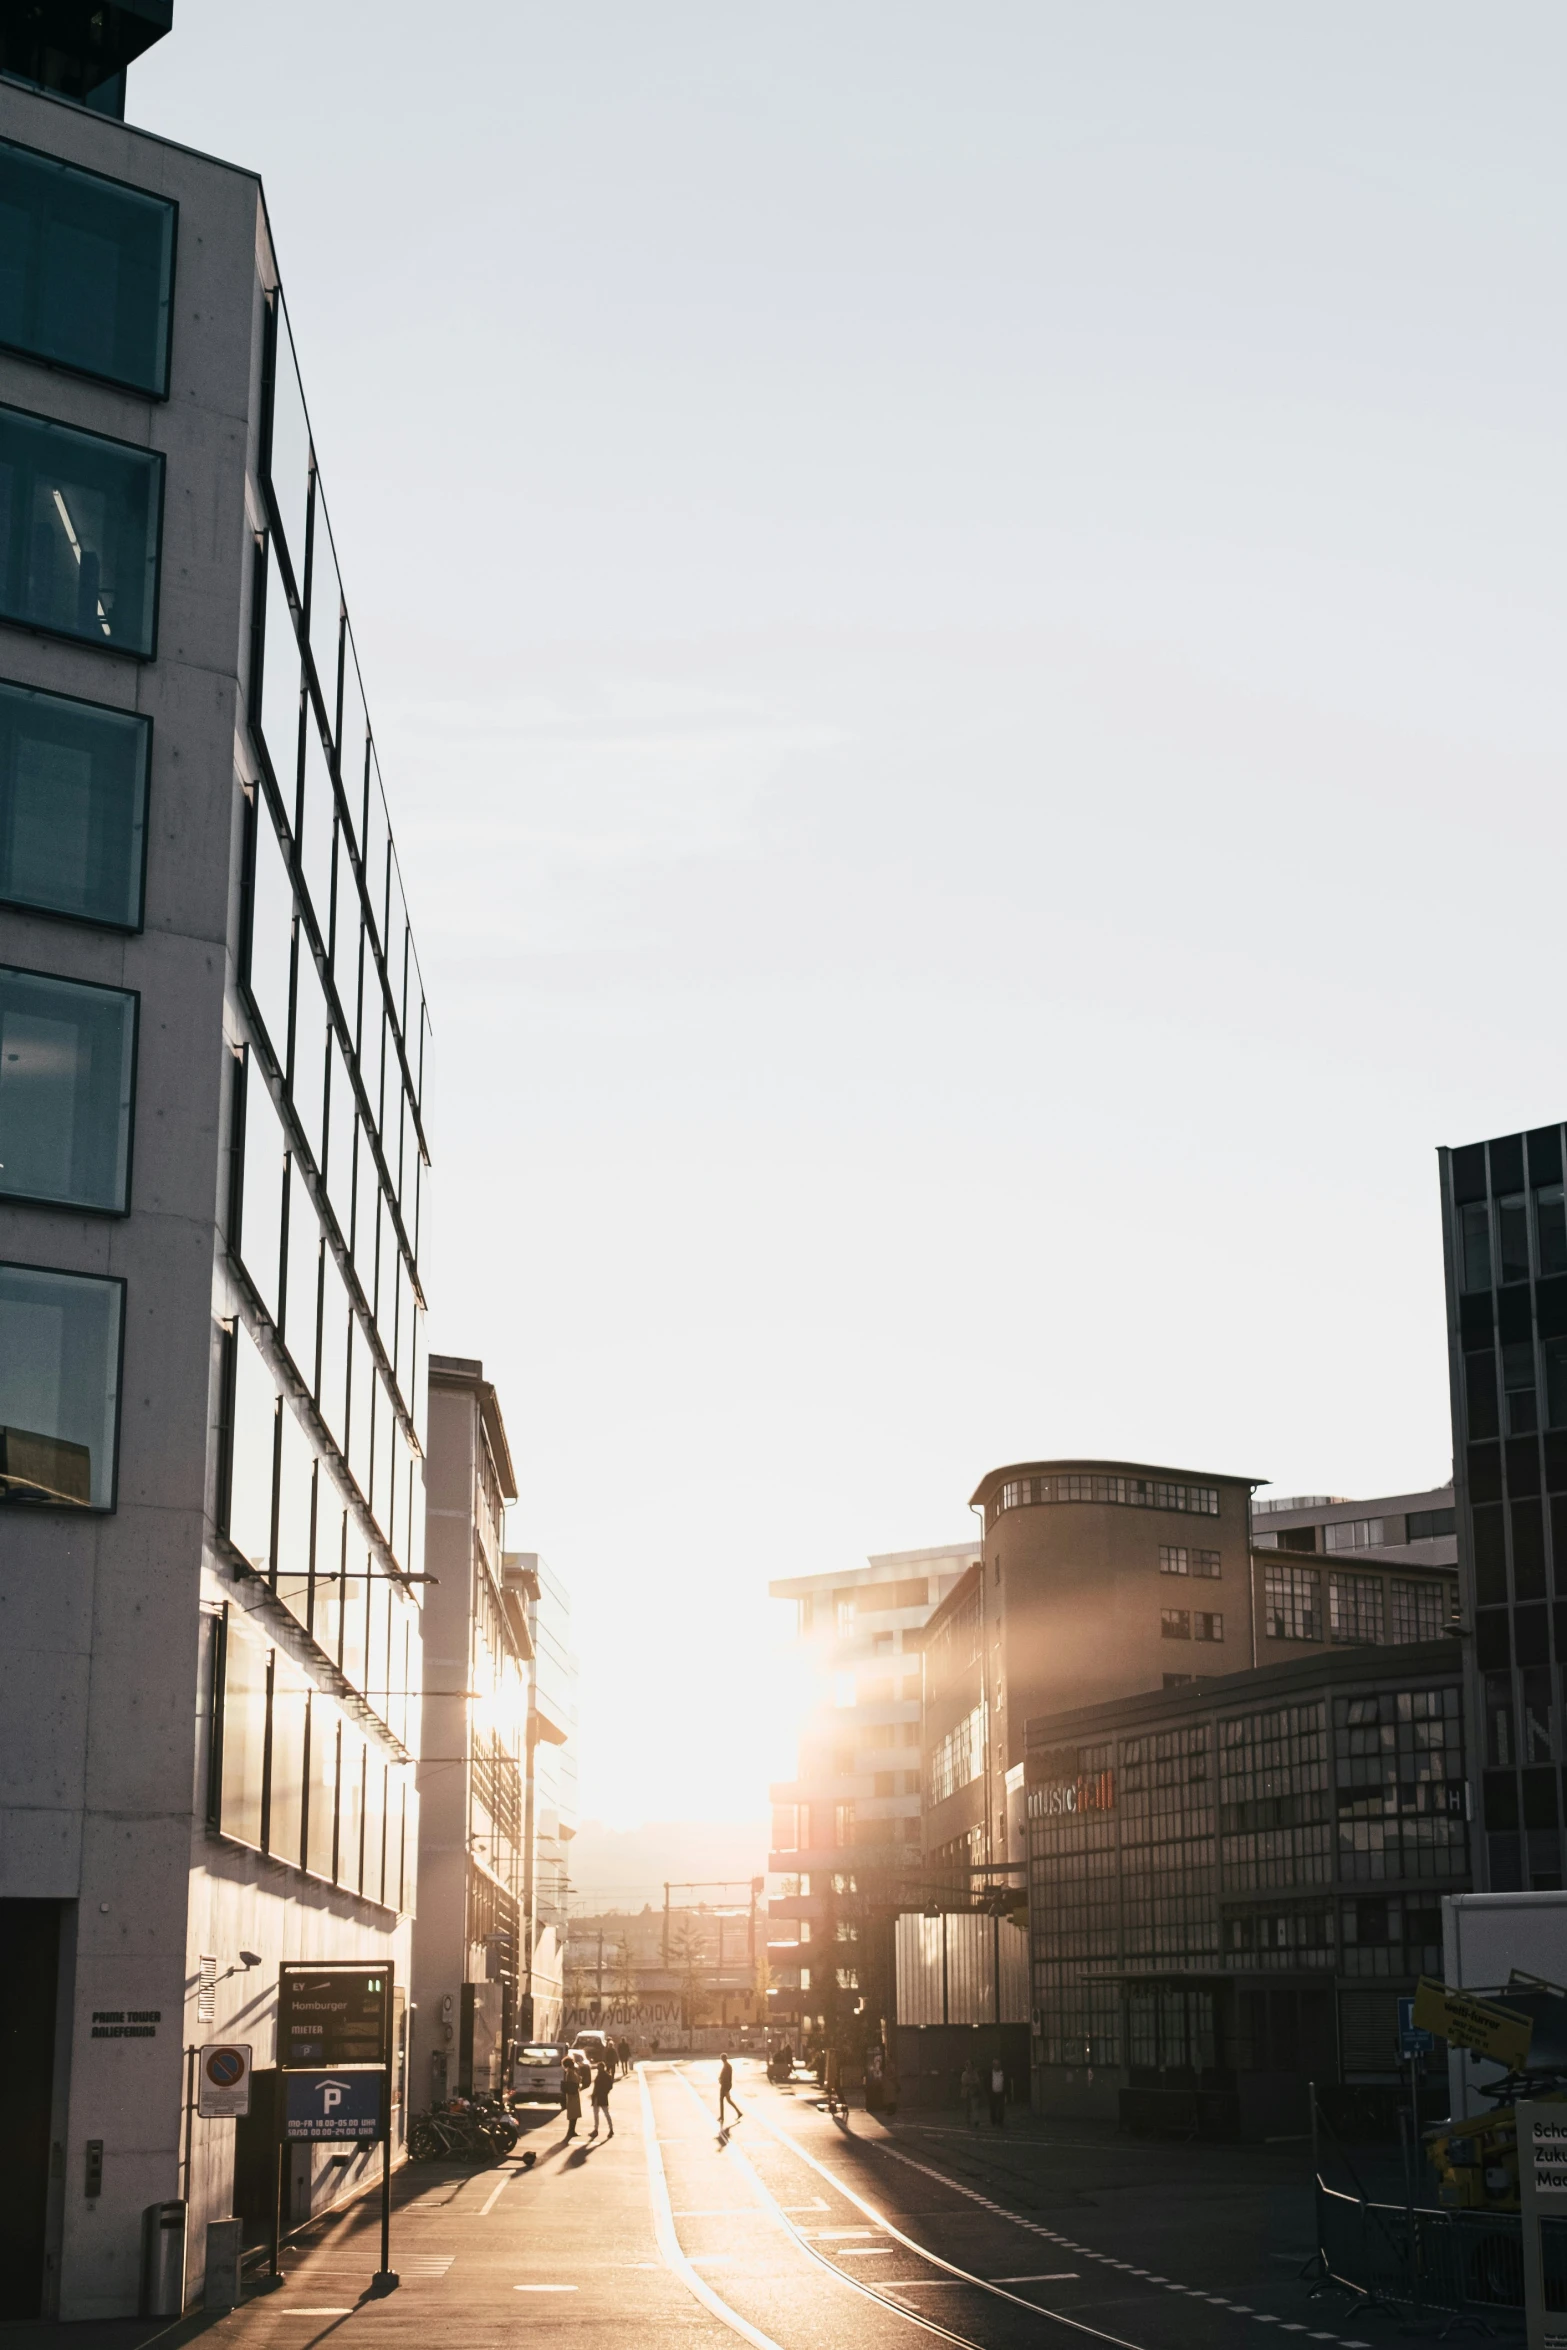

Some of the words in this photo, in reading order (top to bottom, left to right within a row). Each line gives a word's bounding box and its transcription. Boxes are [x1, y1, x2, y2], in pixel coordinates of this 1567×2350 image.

[292, 1982, 305, 1992] EY
[292, 2001, 348, 2012] Homburger
[92, 2011, 125, 2023] PRIME
[127, 2011, 161, 2023] TOWER
[91, 2026, 156, 2038] ANLIEFERUNG
[291, 2025, 323, 2035] MIETER
